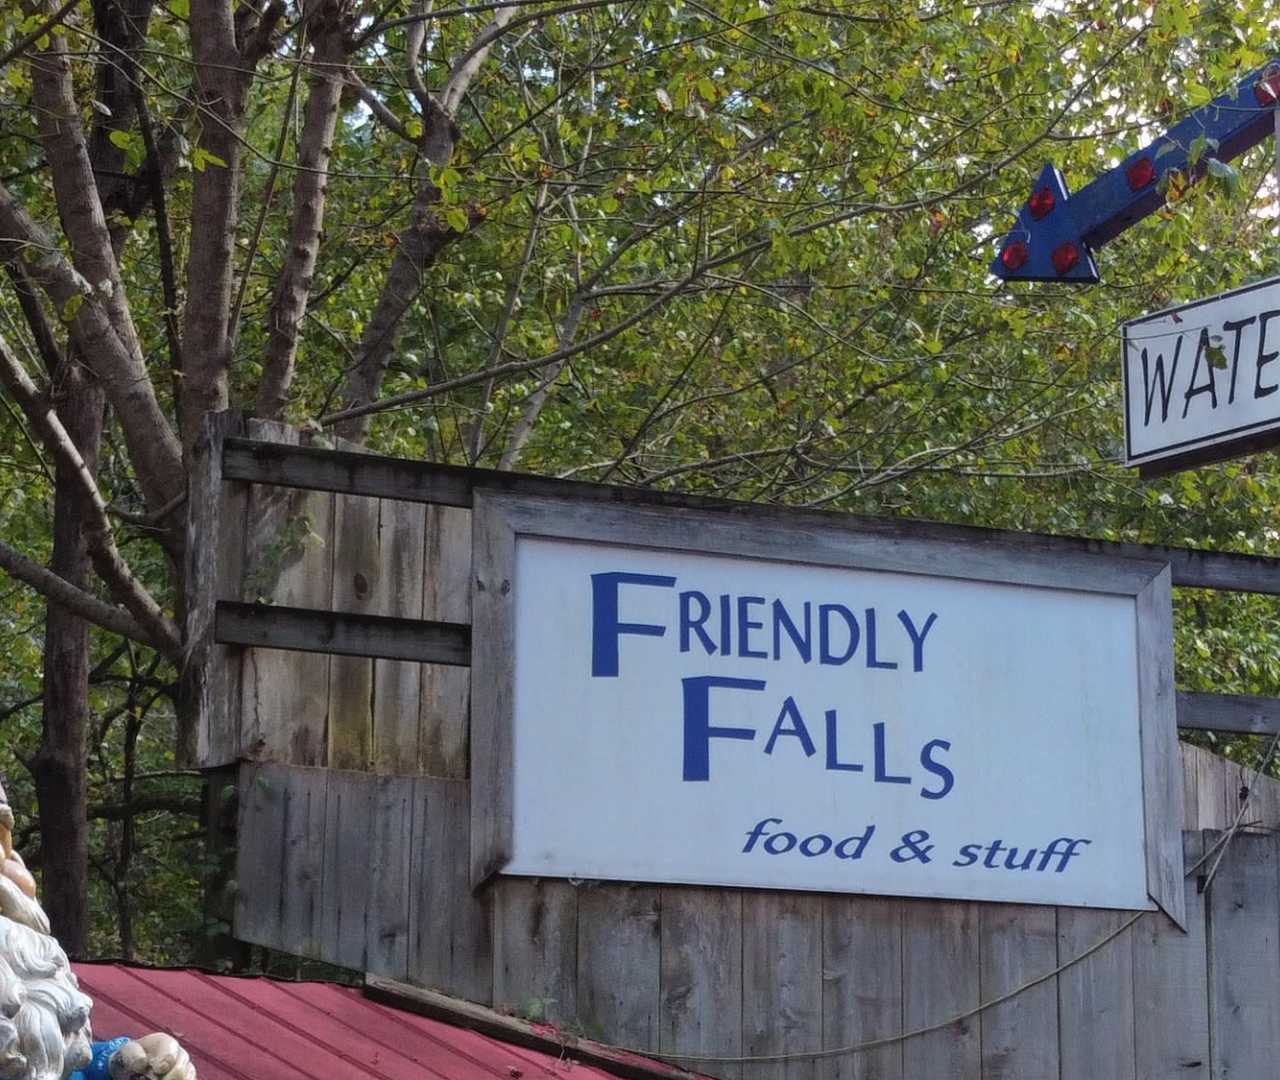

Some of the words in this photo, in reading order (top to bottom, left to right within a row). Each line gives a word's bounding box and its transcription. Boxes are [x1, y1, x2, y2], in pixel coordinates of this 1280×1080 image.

[591, 571, 938, 677] FRIENDLY
[682, 675, 955, 800] FALLS
[742, 818, 875, 860] food
[890, 830, 932, 864] &
[953, 837, 1091, 873] stuff
